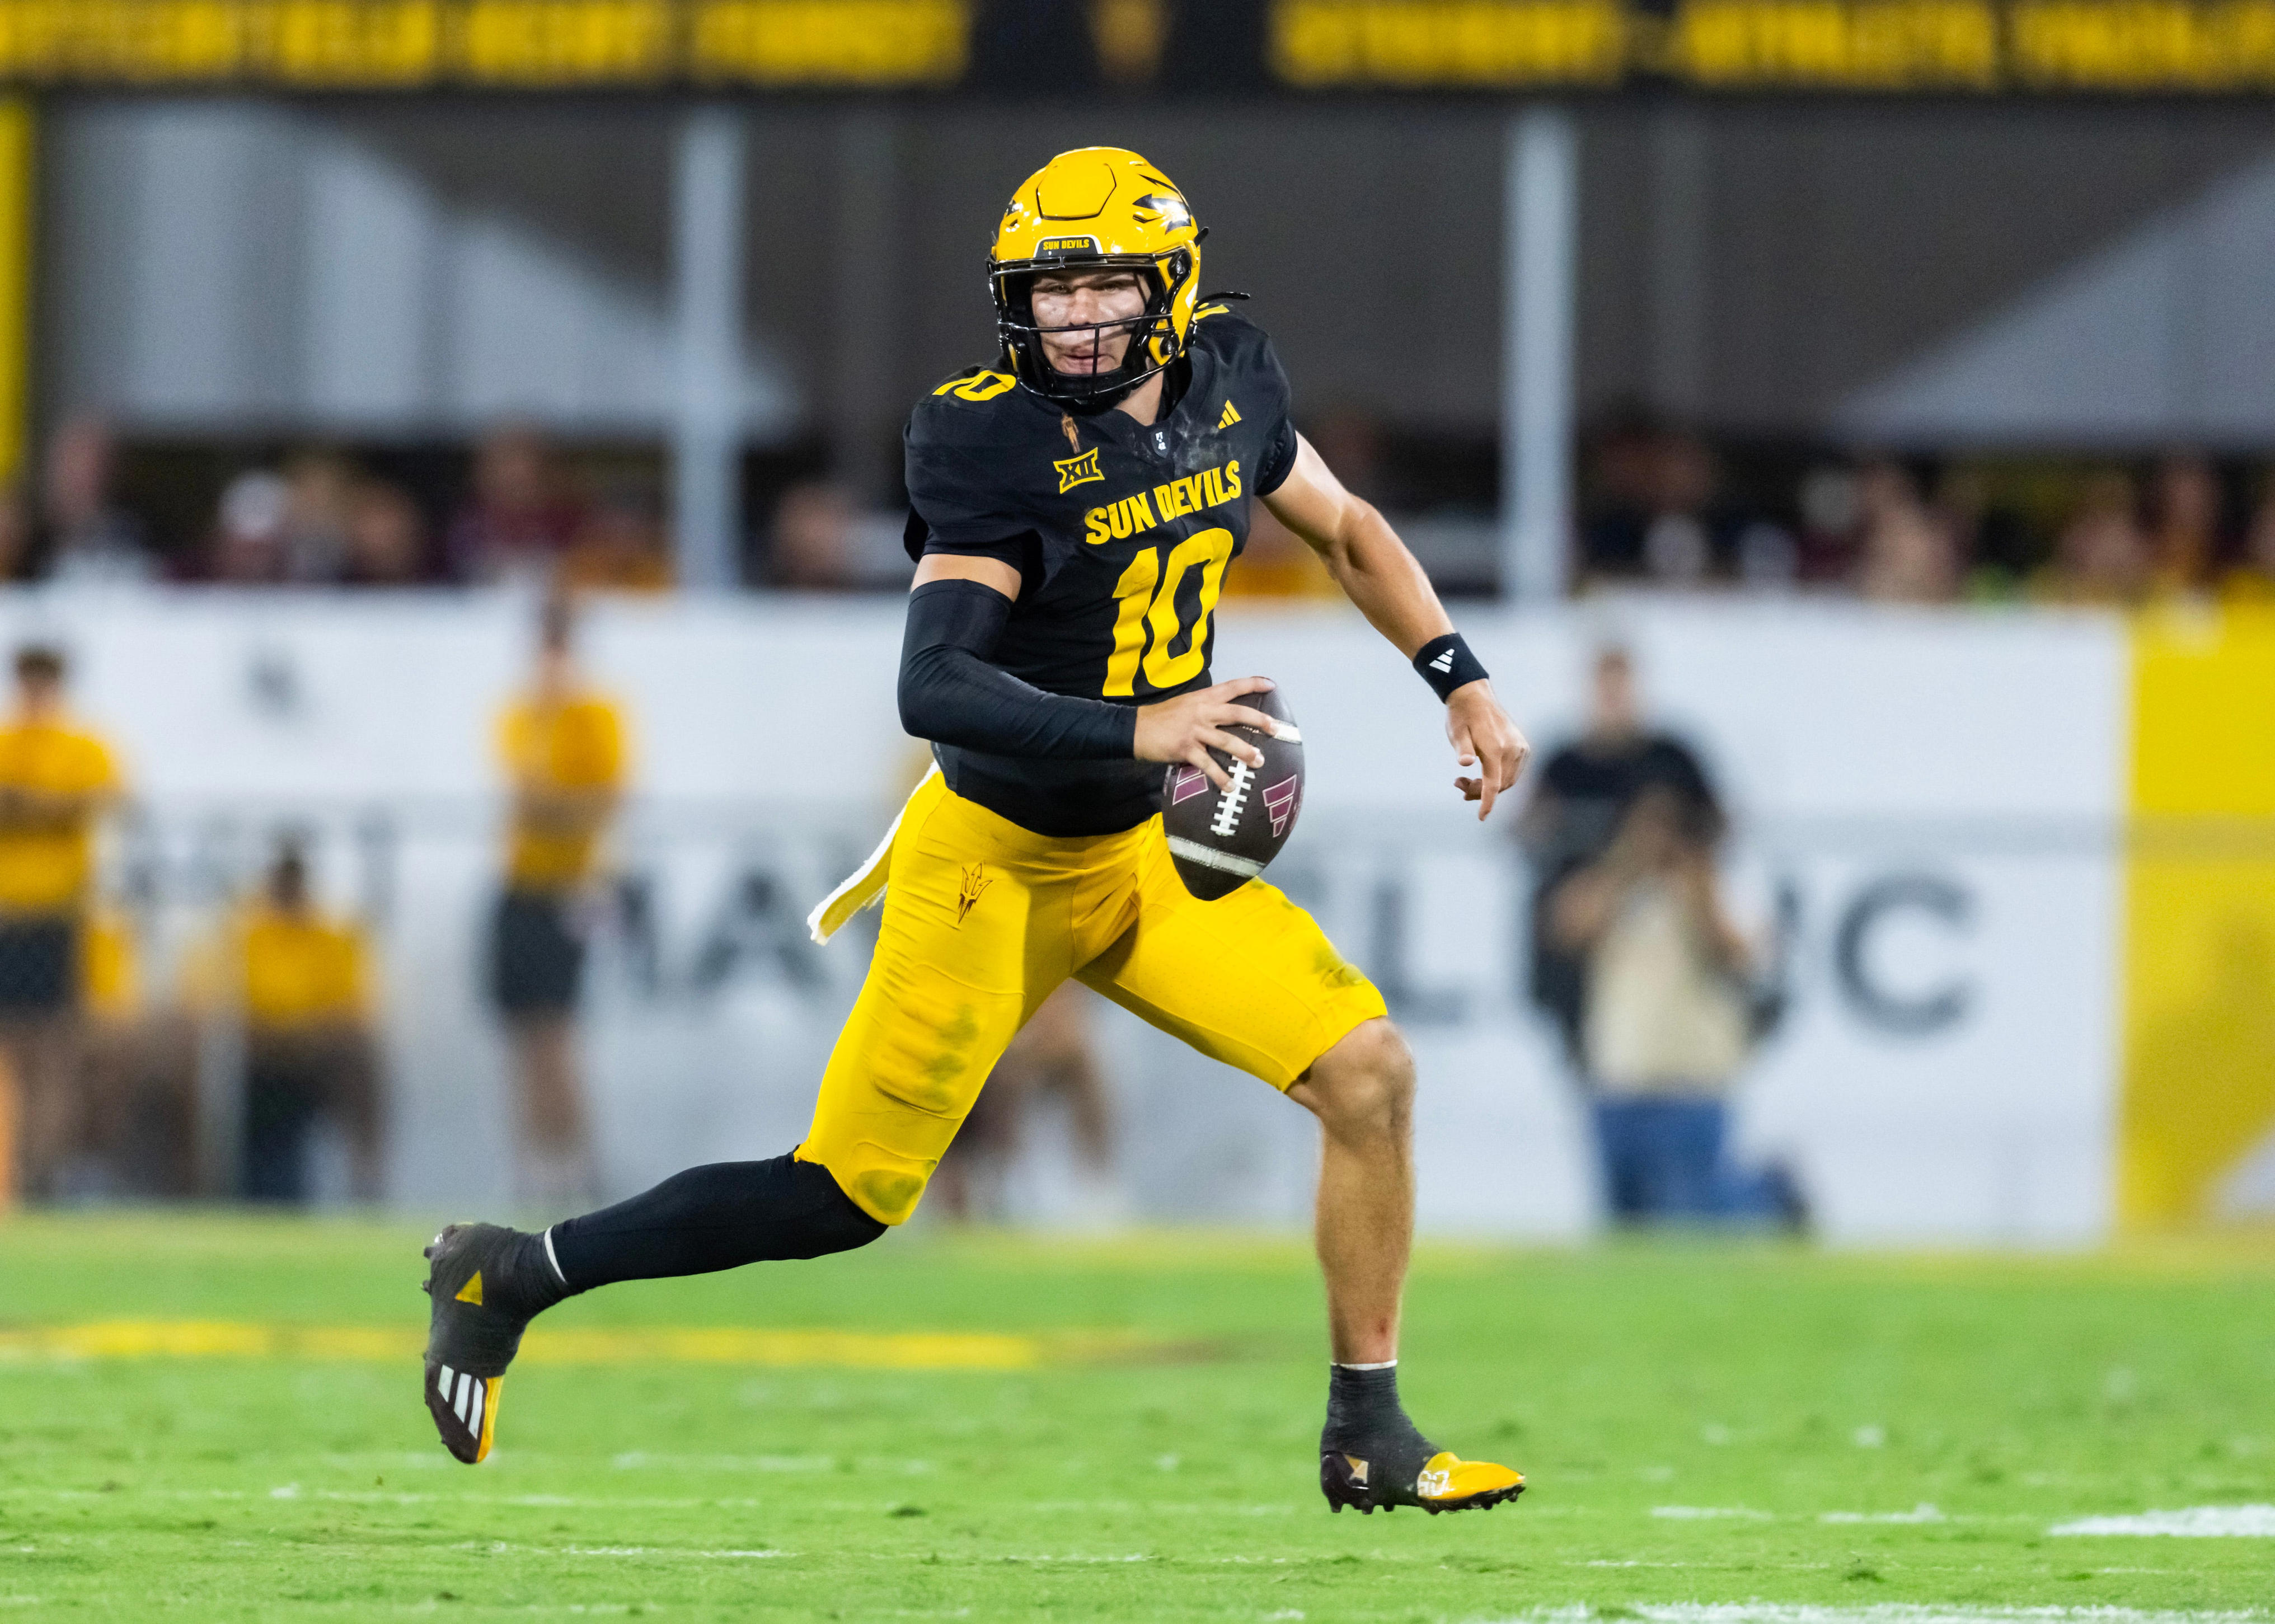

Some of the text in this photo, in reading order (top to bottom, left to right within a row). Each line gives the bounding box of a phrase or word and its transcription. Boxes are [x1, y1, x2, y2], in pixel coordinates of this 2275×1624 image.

[1043, 239, 1090, 251] SUN DEVILS
[931, 369, 1016, 402] 10
[1084, 459, 1242, 545] SUN DEVILS
[1103, 527, 1234, 697] 10
